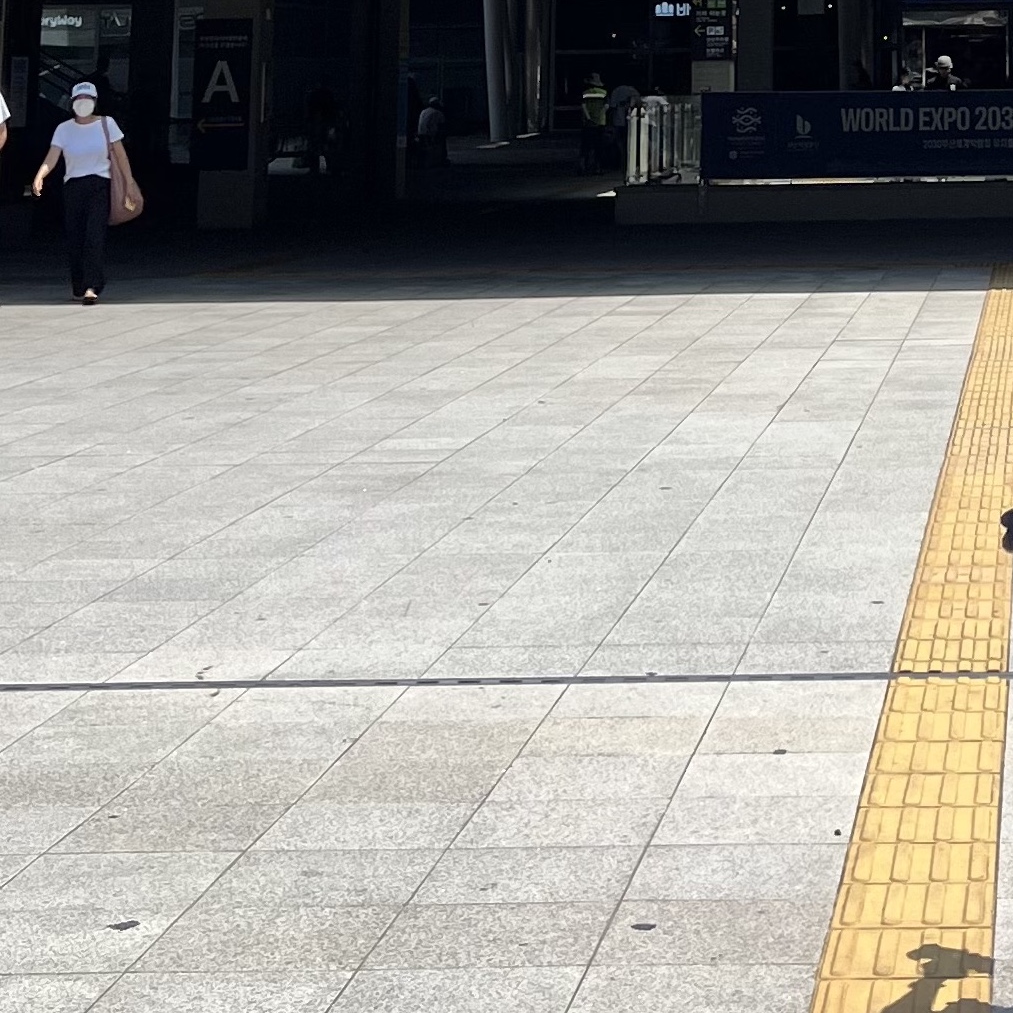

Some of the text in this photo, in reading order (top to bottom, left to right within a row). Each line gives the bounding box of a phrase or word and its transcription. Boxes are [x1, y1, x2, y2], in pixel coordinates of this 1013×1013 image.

[201, 60, 240, 103] A
[841, 107, 914, 133] WORLD
[918, 106, 971, 131] EXPO
